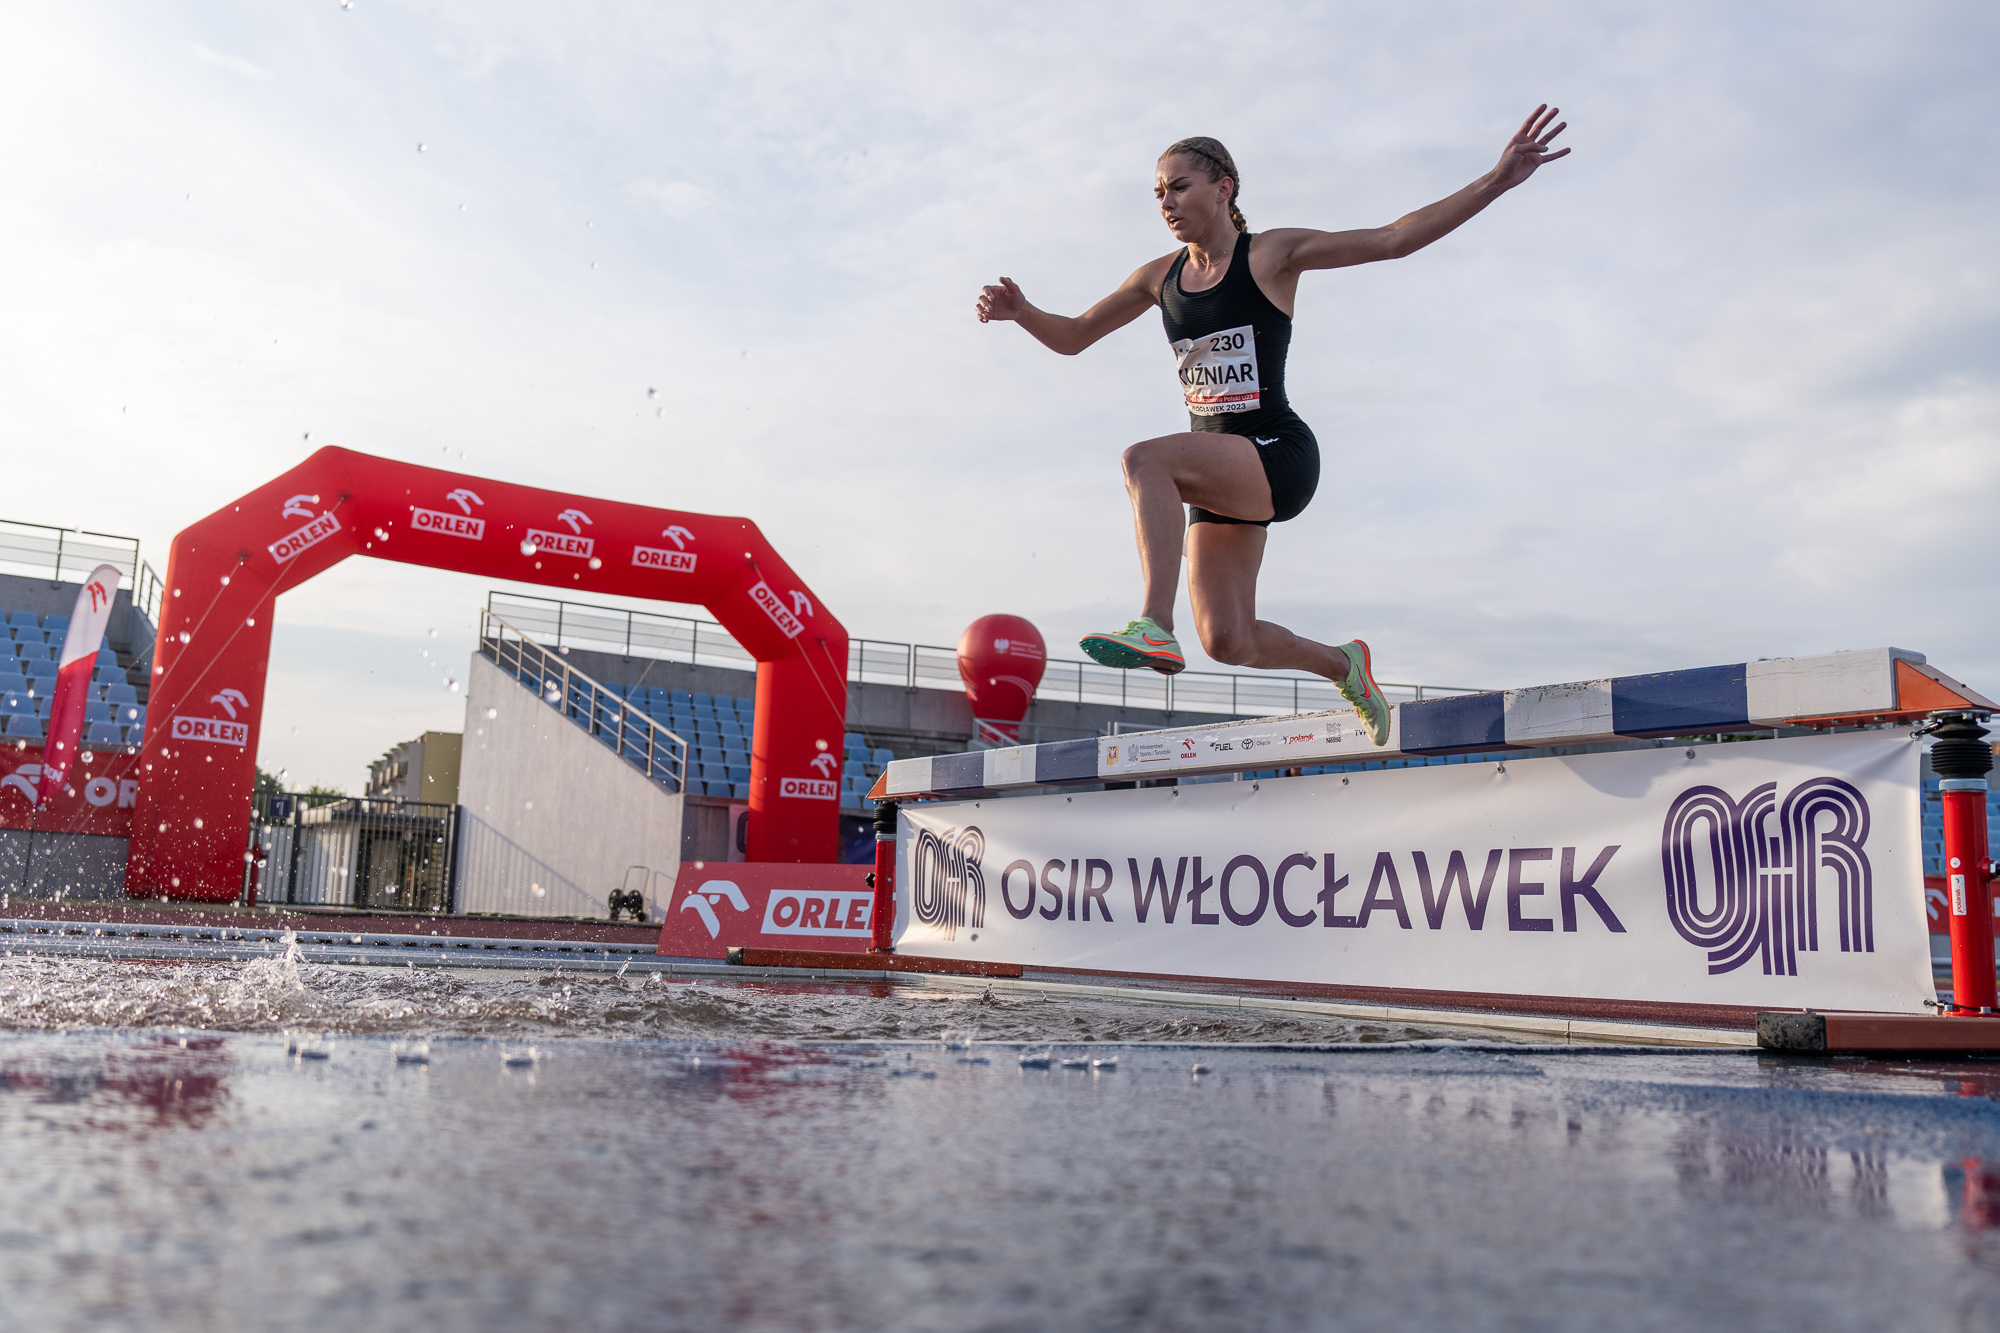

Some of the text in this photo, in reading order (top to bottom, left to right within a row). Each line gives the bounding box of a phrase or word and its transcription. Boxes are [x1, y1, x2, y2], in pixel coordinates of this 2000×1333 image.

[1210, 333, 1245, 352] 230
[1192, 402, 1246, 413] OCŁAWEK 2023
[1224, 395, 1241, 403] Polski
[417, 512, 480, 537] ORLEN
[275, 517, 336, 559] ORLEN
[531, 533, 589, 556] ORLEN
[637, 550, 692, 571] ORLEN
[754, 587, 798, 635] ORLEN
[177, 719, 245, 743] ORLEN
[1289, 733, 1315, 744] polanik
[784, 781, 834, 797] ORLEN
[1001, 845, 1627, 934] OSIR WŁOCŁAWEK
[772, 896, 874, 930] ORLE
